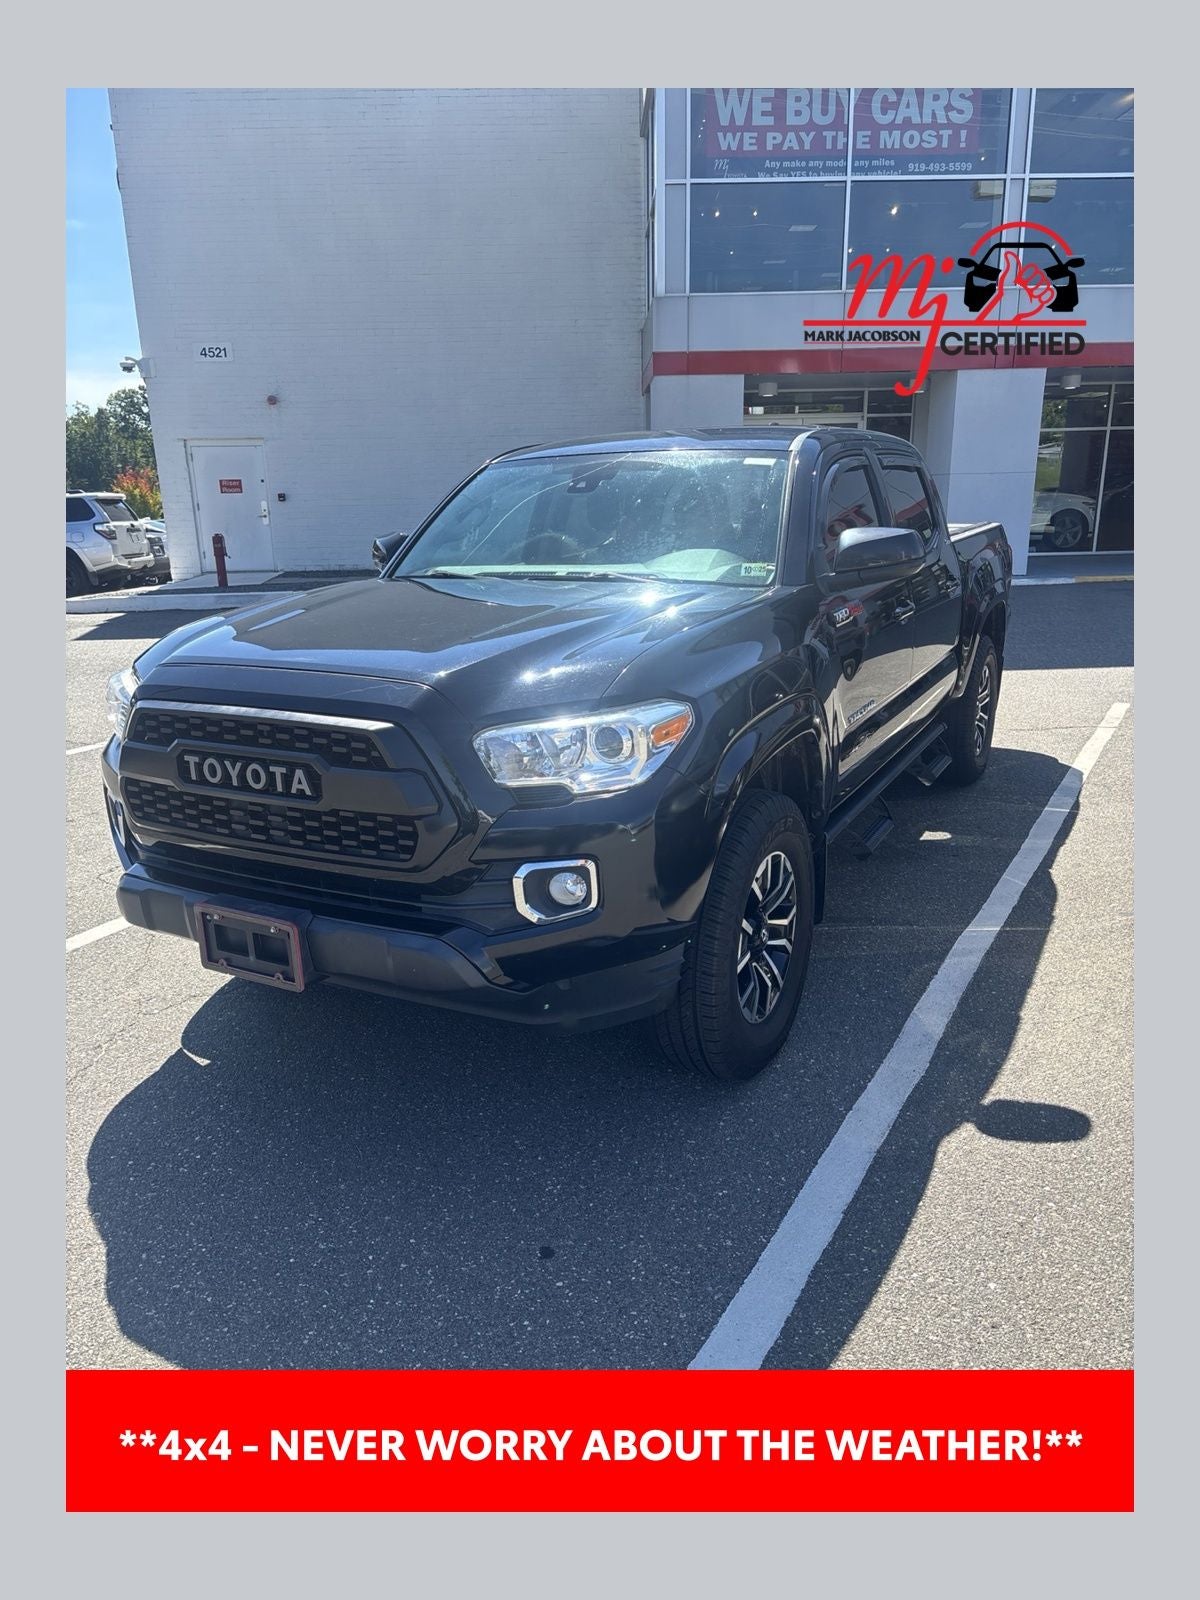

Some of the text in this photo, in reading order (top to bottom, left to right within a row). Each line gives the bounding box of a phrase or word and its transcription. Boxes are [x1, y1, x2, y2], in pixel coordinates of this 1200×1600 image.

[714, 88, 974, 126] WE BUY CARS
[717, 129, 968, 151] WE PAY THE MOST !
[764, 158, 895, 169] Any make any mod any miles
[908, 162, 973, 172] 919-493-5599
[790, 170, 807, 178] YES
[199, 347, 228, 359] 4521
[184, 755, 312, 796] TOYOTA
